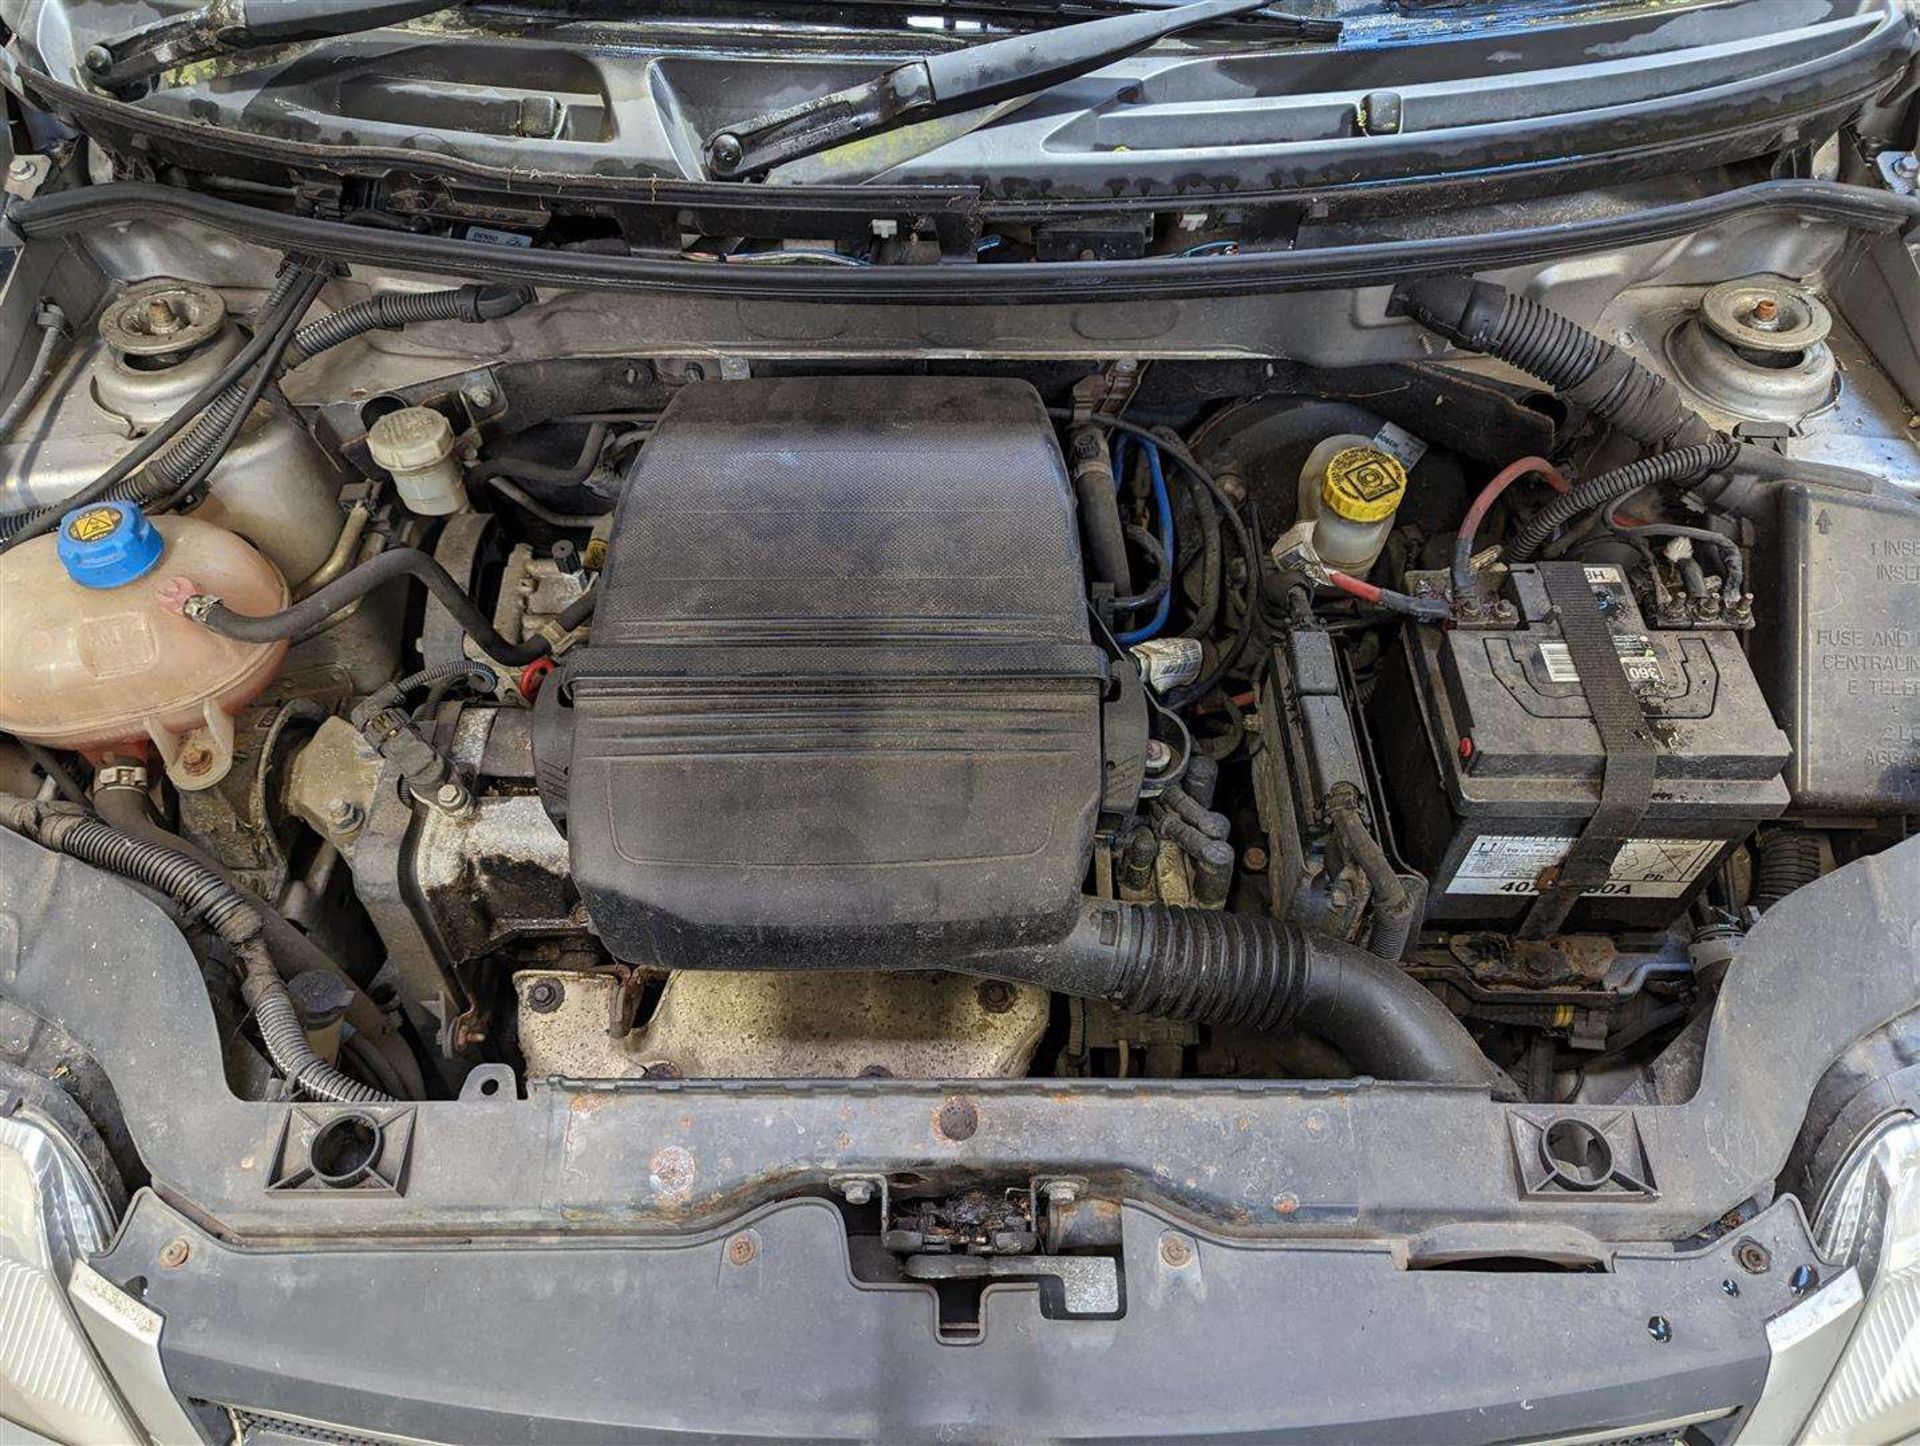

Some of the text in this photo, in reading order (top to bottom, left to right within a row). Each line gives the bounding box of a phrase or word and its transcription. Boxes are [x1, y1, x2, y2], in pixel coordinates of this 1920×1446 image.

[1817, 630, 1864, 647] FUSE
[1872, 631, 1909, 647] AND
[1628, 666, 1660, 680] 360
[1847, 680, 1860, 695] E
[1642, 872, 1665, 881] Pb
